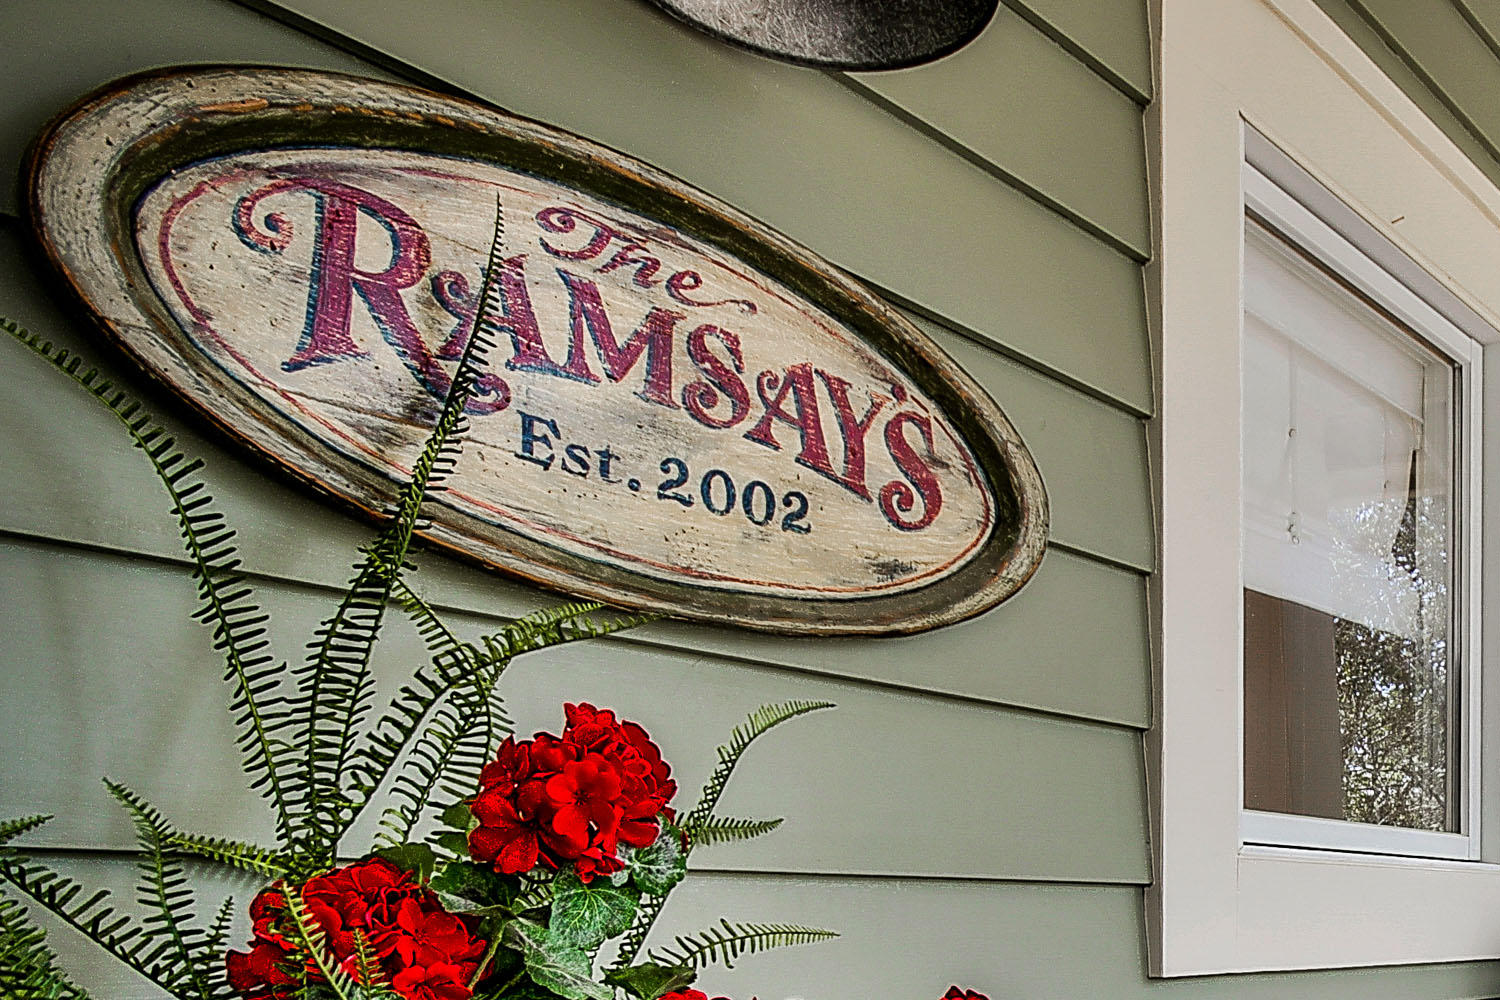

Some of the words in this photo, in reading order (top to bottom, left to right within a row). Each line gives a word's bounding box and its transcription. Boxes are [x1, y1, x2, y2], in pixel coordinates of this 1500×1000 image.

[535, 206, 757, 314] The
[231, 177, 943, 533] RAMSAY'S
[514, 410, 642, 492] Est.
[657, 457, 812, 534] 2002
